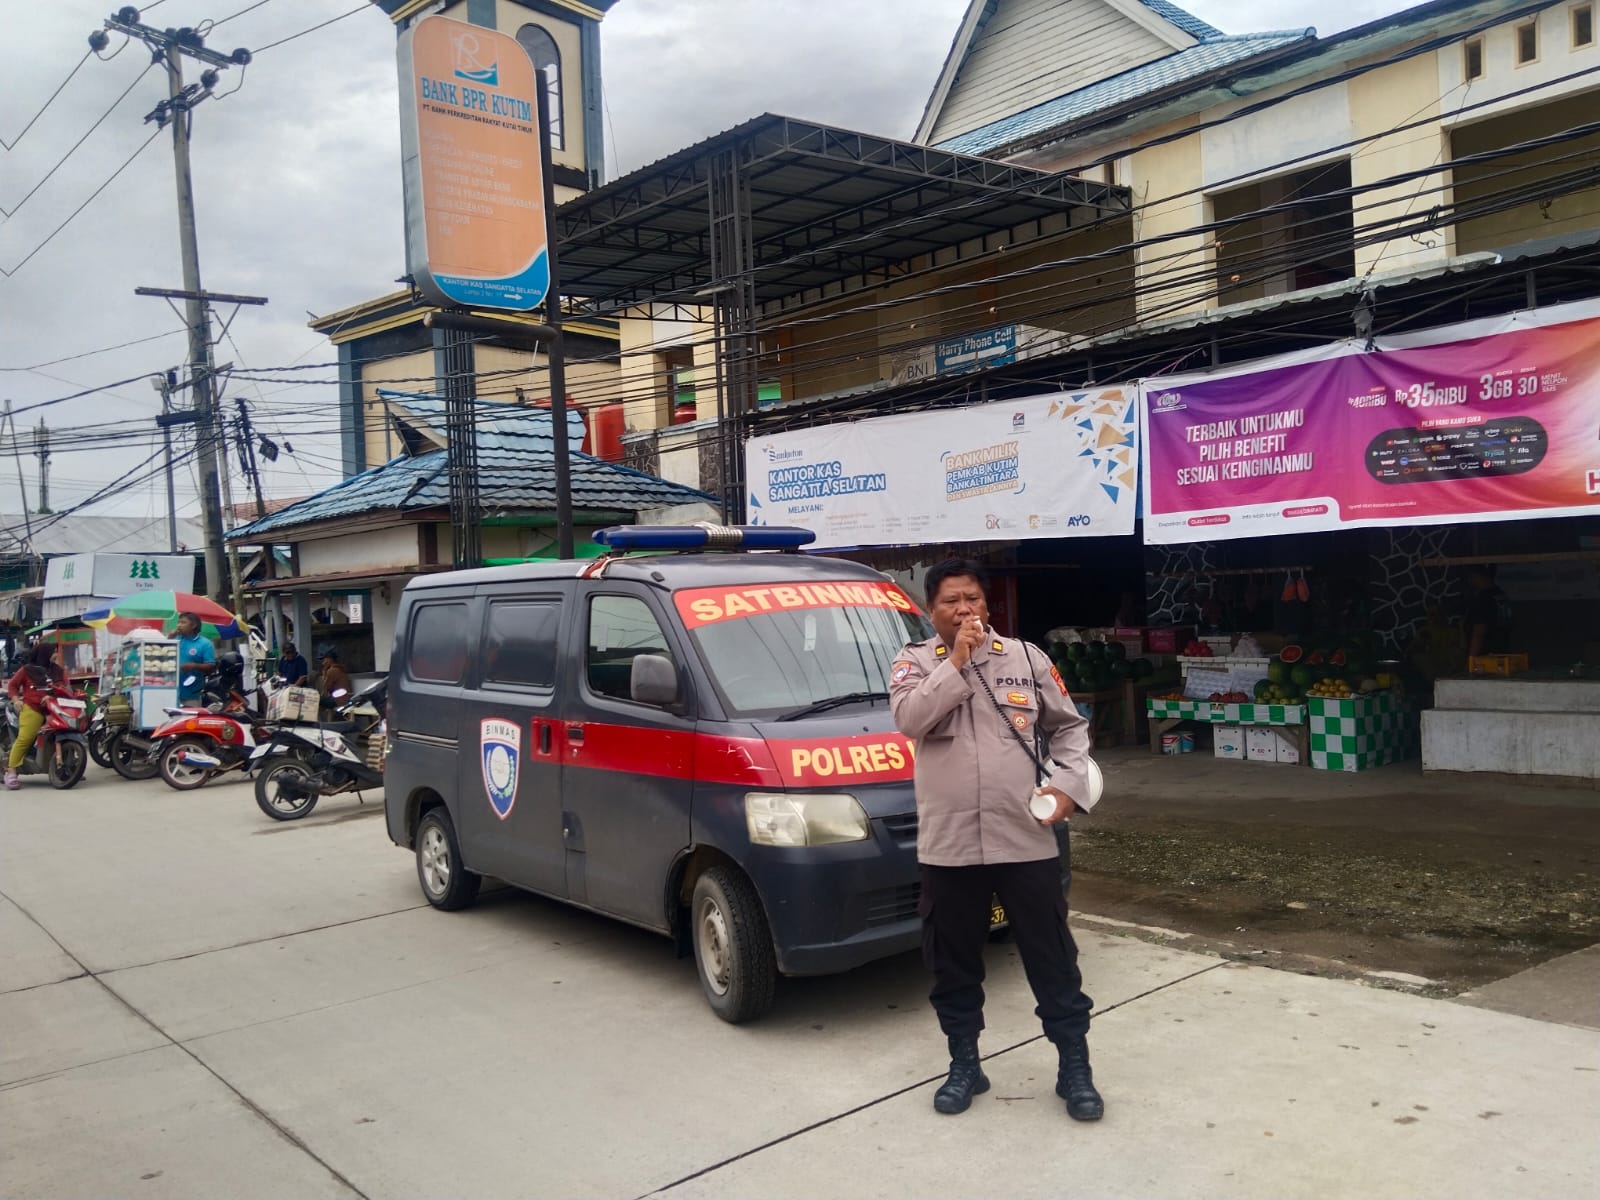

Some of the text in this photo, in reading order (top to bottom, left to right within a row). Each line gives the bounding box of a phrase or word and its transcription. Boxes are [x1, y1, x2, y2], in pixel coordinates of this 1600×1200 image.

[421, 77, 532, 122] BANK BPR KUTIM
[443, 278, 469, 287] KANTOR
[470, 281, 484, 289] KAS
[484, 282, 515, 292] SANGATTA
[938, 328, 1013, 358] Harry Phone Cell
[907, 361, 928, 379] BNI
[1479, 373, 1513, 400] 3GB
[1518, 375, 1538, 396] 30
[1185, 409, 1304, 443] TERBAIK UNTUKMU
[946, 441, 1018, 471] BANK MILIK
[1200, 433, 1288, 462] PILIH BENEFIT
[769, 462, 841, 486] KANTOR KAS
[947, 456, 1018, 482] PEMKAB KUTIM
[1177, 452, 1313, 485] SESUAI KEINGINANMU
[769, 474, 885, 501] SANGATTA SELATAN
[1067, 515, 1091, 527] AYO
[690, 584, 912, 621] SATBINMAS
[996, 677, 1034, 687] POLRI
[792, 743, 906, 777] POLRES
